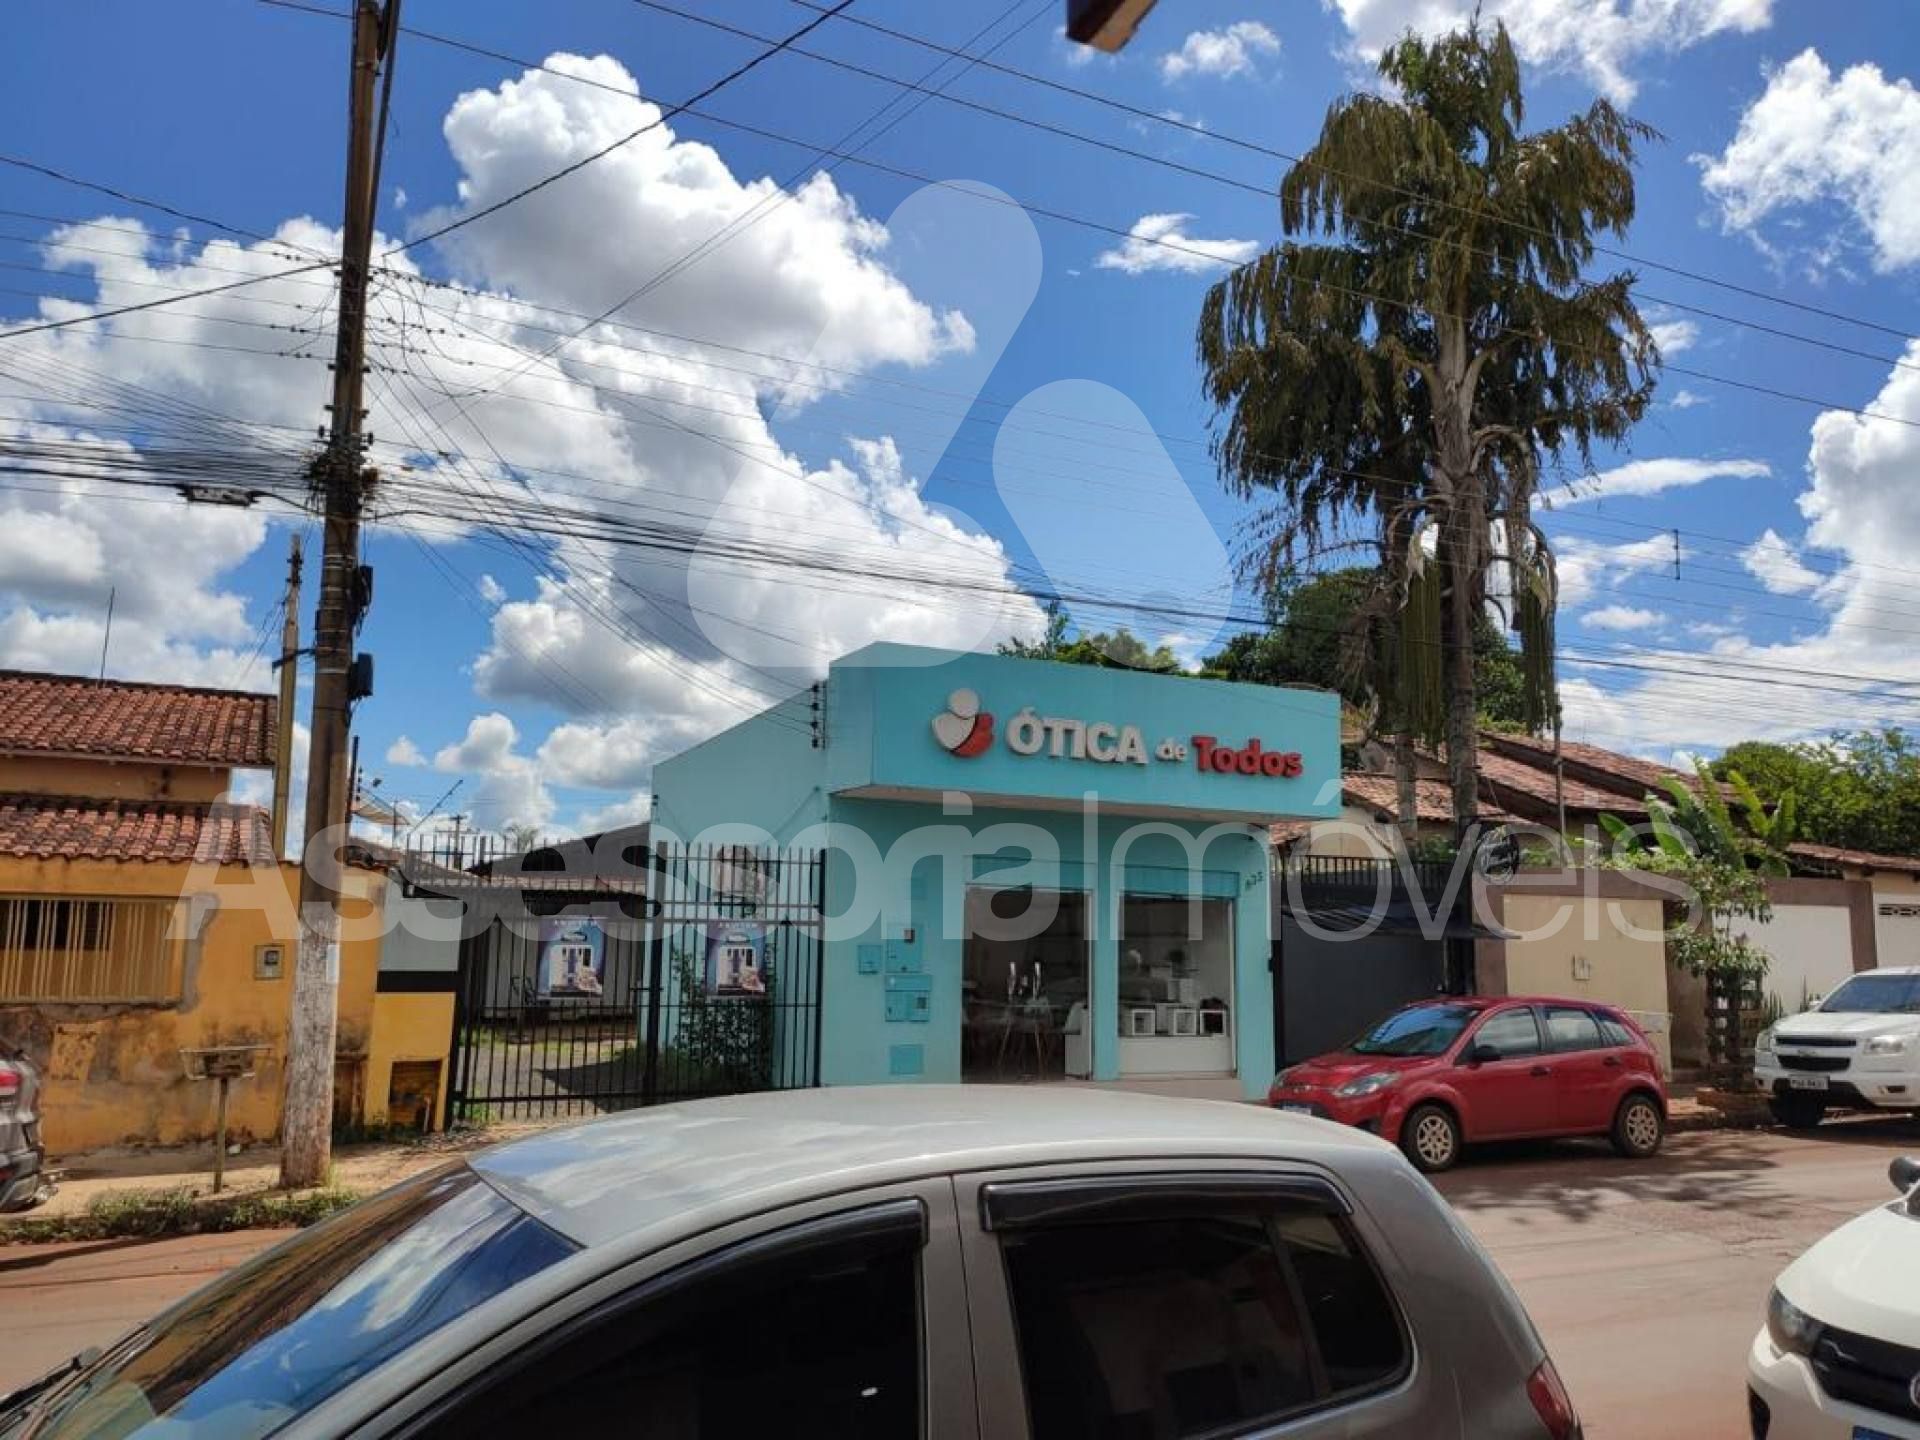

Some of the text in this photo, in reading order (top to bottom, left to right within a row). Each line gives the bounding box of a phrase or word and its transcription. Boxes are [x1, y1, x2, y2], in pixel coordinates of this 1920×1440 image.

[1007, 708, 1302, 777] ÓTICA de Todos
